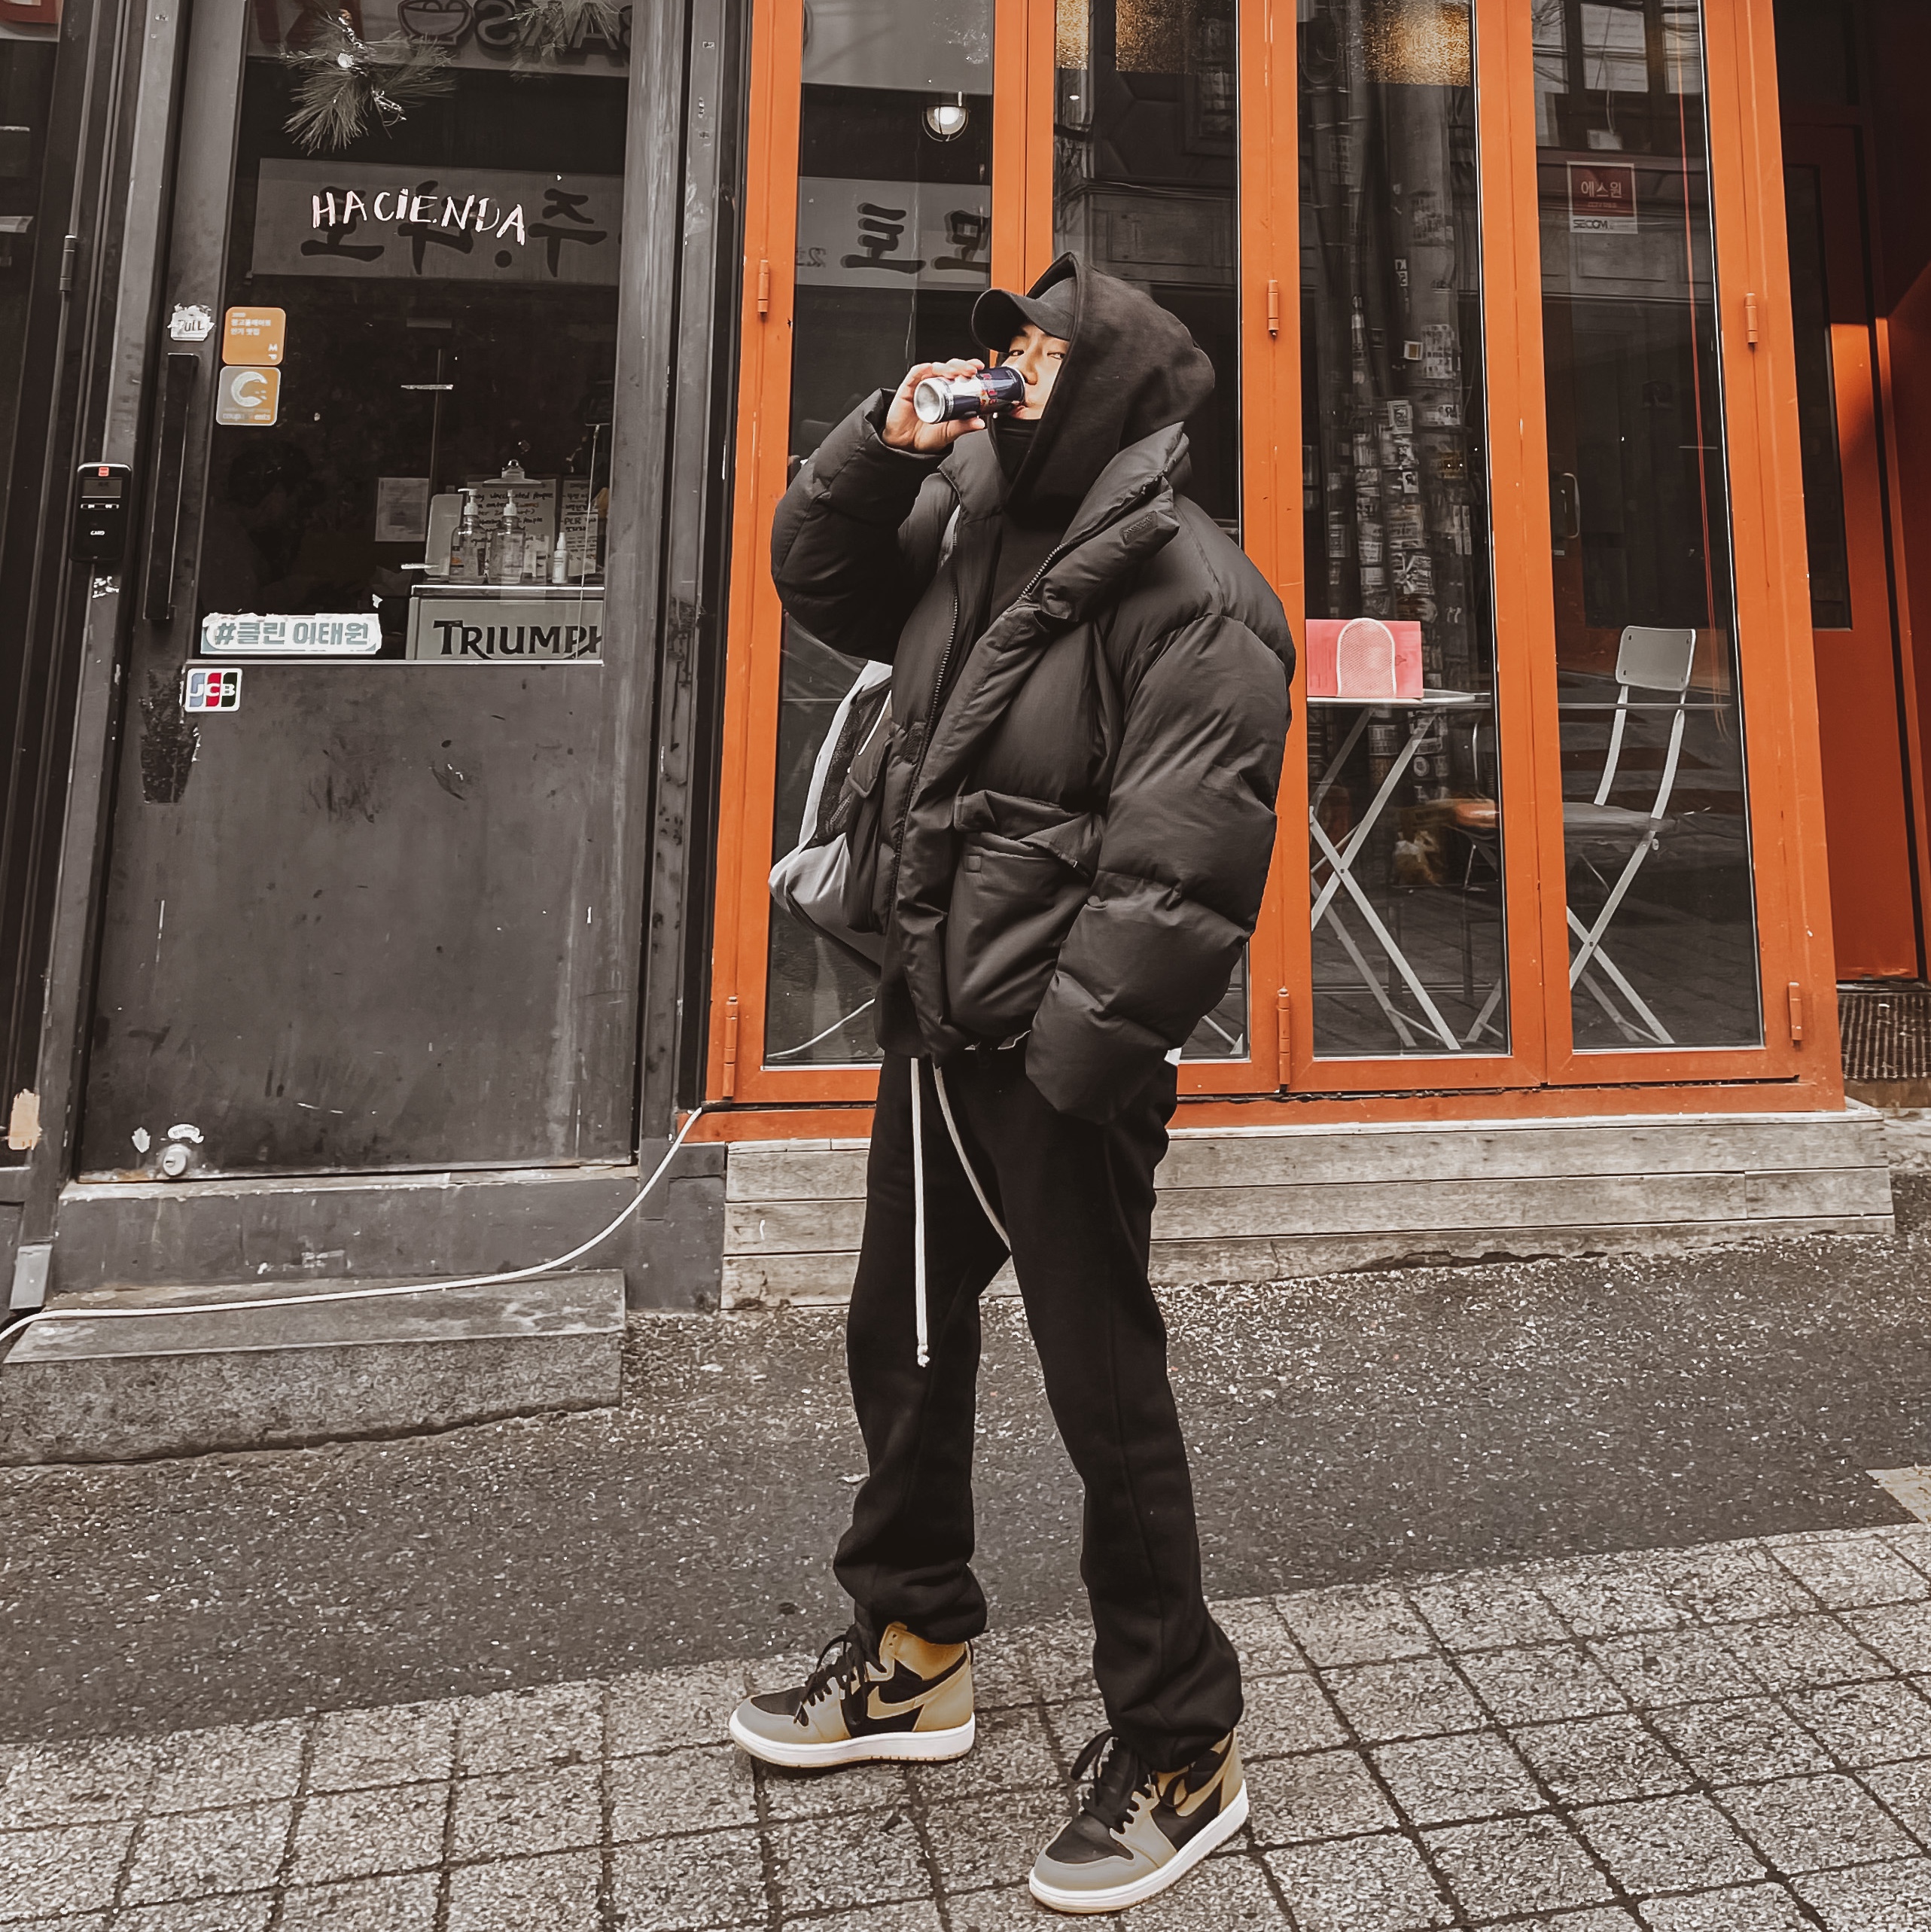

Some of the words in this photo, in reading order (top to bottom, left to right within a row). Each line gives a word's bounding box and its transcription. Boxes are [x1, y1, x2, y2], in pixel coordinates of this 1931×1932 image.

[1581, 181, 1622, 198] 에스원
[215, 621, 285, 645] #클린
[292, 621, 369, 645] 이태원
